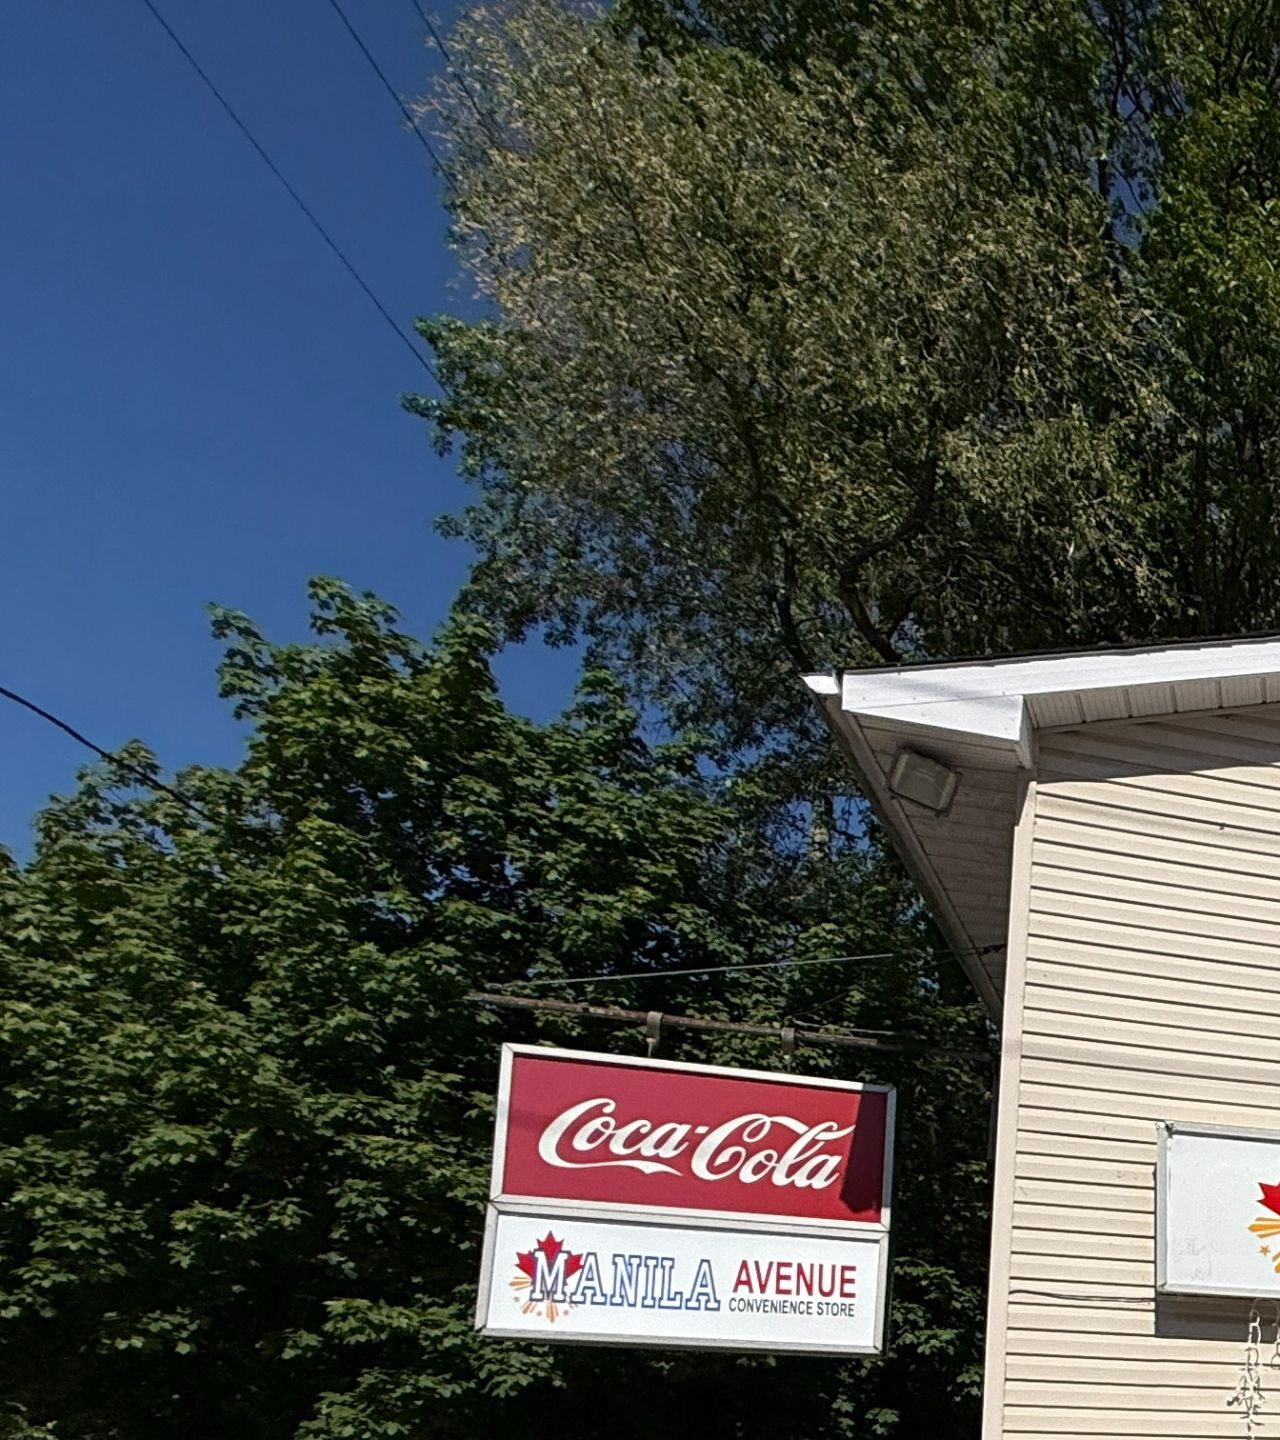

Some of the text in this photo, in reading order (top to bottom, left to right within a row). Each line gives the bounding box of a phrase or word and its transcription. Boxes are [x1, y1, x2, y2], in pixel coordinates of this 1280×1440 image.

[538, 1097, 856, 1190] Coca-Cola
[529, 1248, 721, 1312] MANILA
[732, 1259, 857, 1299] AVENUE
[728, 1297, 855, 1318] CONVENIENCE STORE
